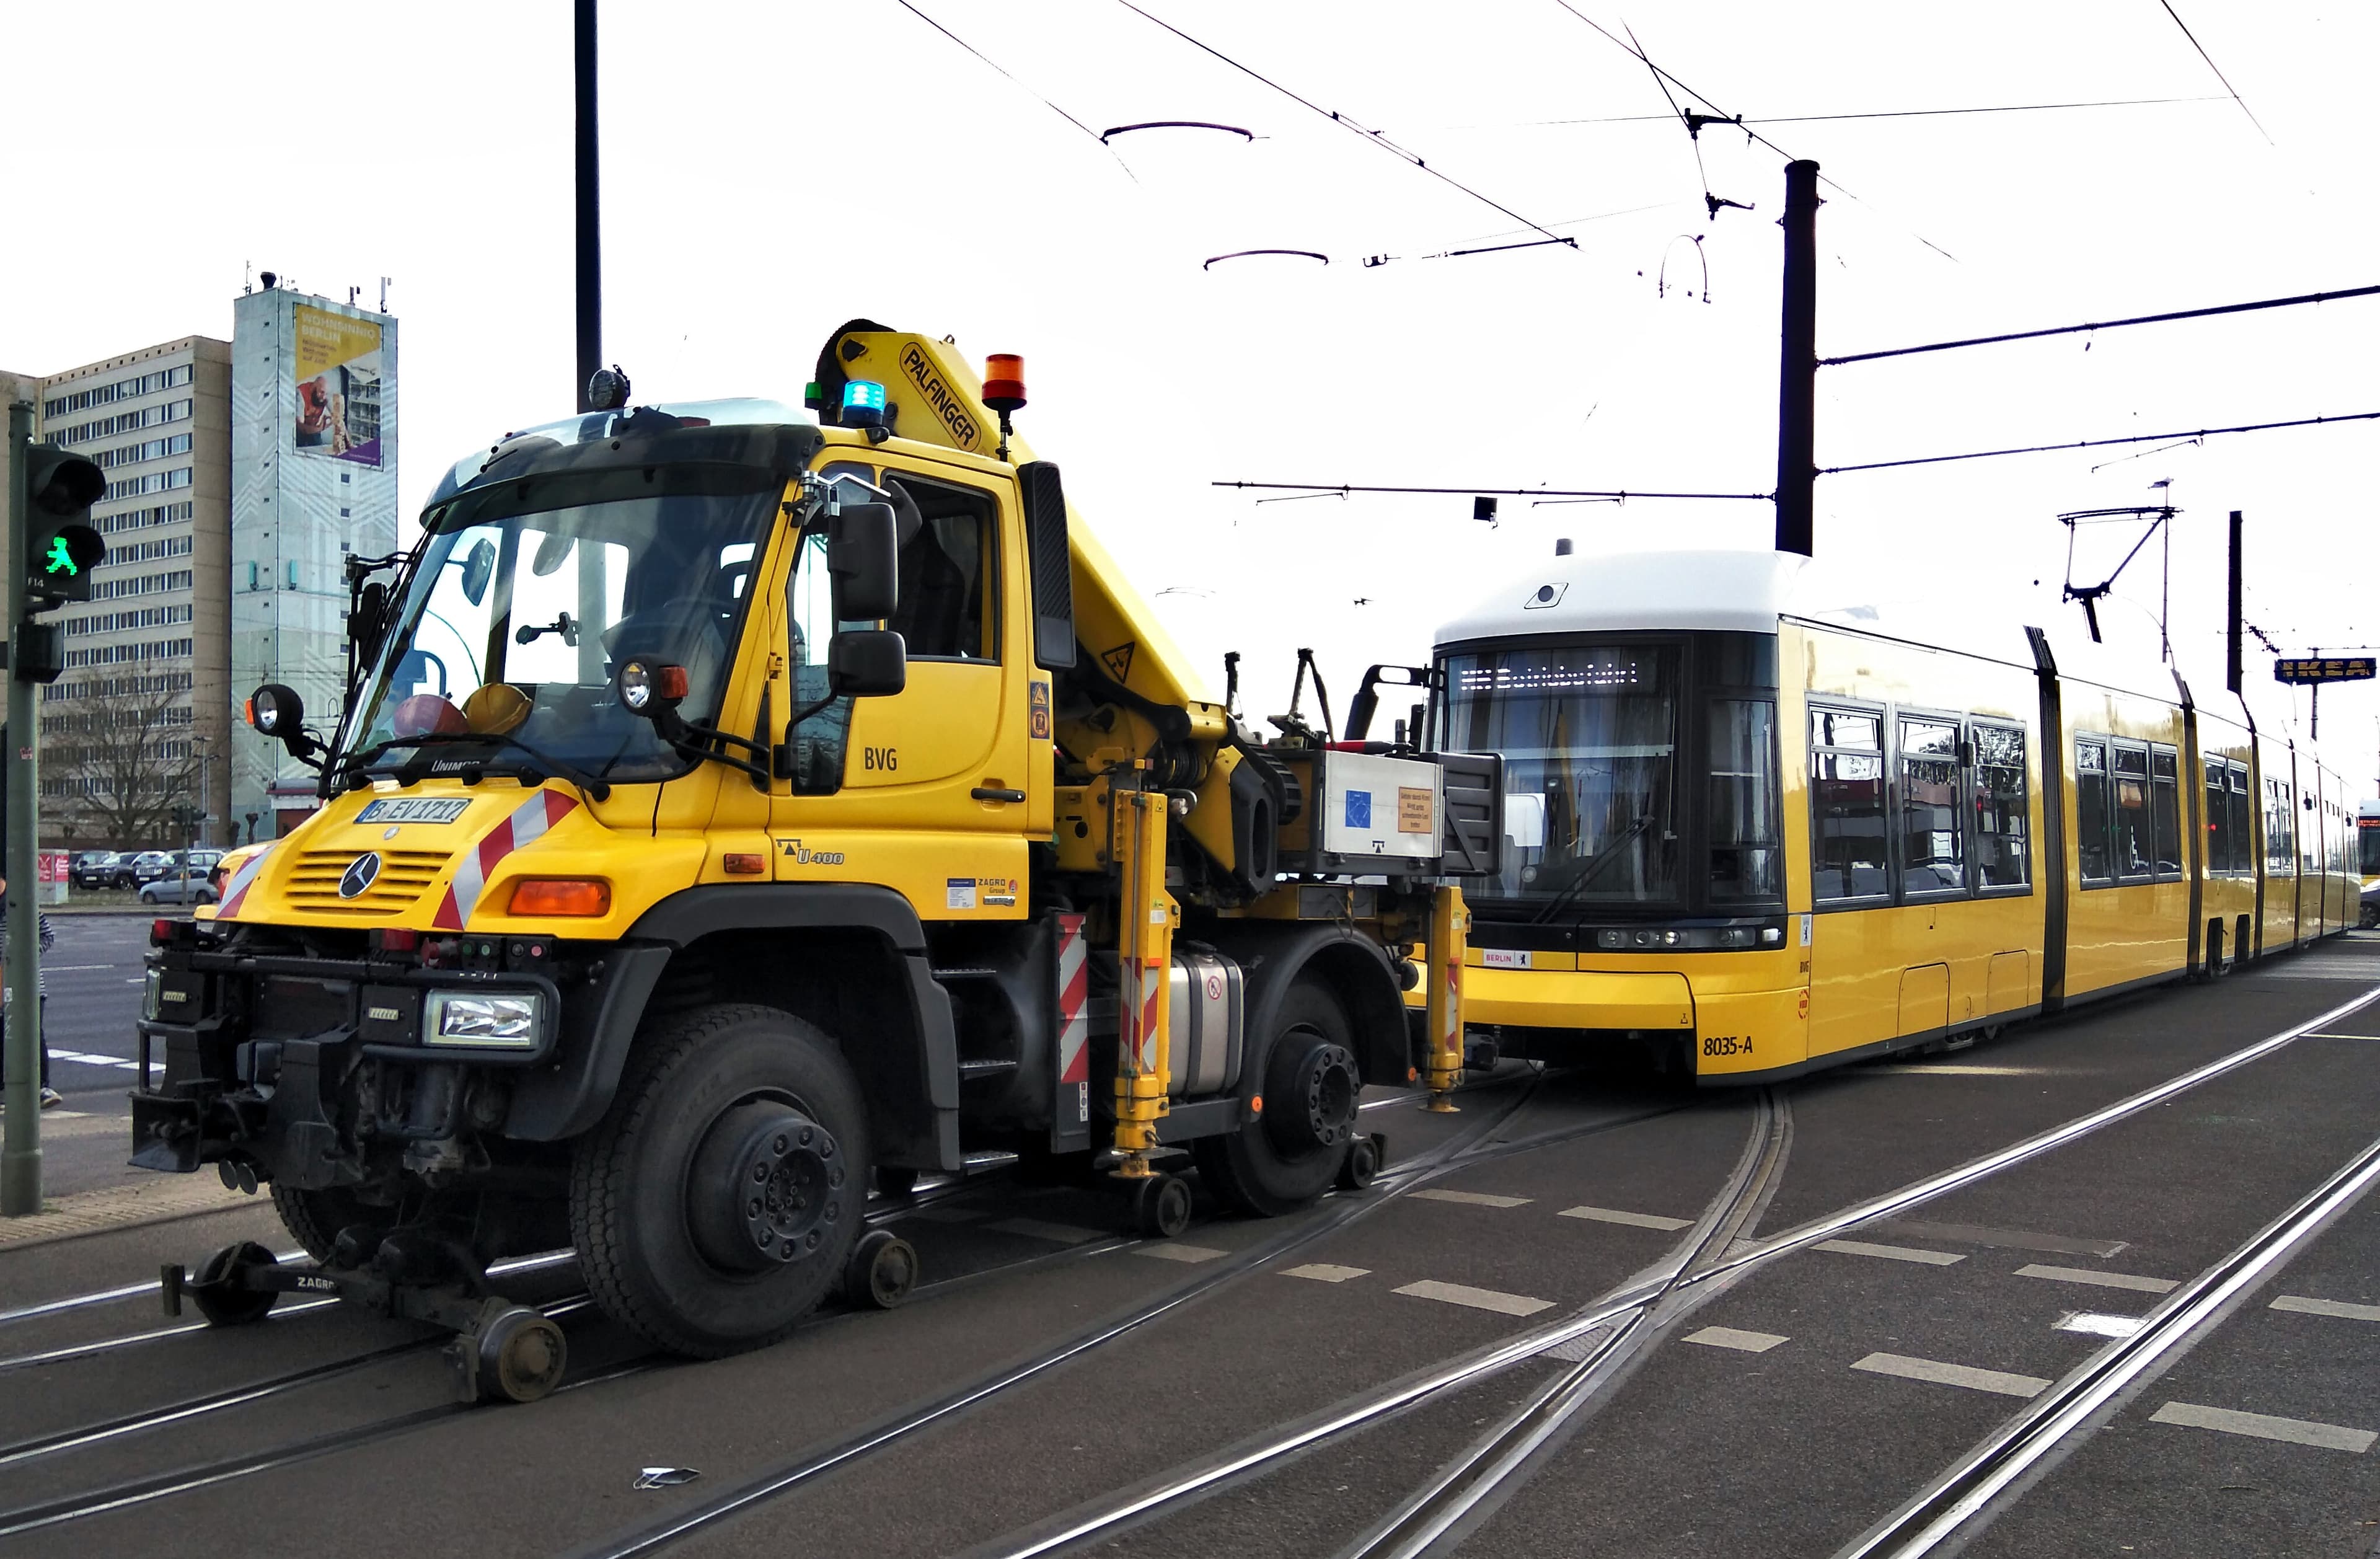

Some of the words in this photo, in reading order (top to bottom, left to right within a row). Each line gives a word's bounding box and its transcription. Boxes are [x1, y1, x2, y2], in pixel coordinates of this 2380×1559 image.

[302, 325, 340, 343] BERLIN
[904, 349, 974, 446] PALFINGER
[2283, 661, 2369, 676] IKEA
[865, 747, 897, 771] BVG
[368, 802, 388, 819] B
[1703, 1036, 1753, 1056] 8035-A
